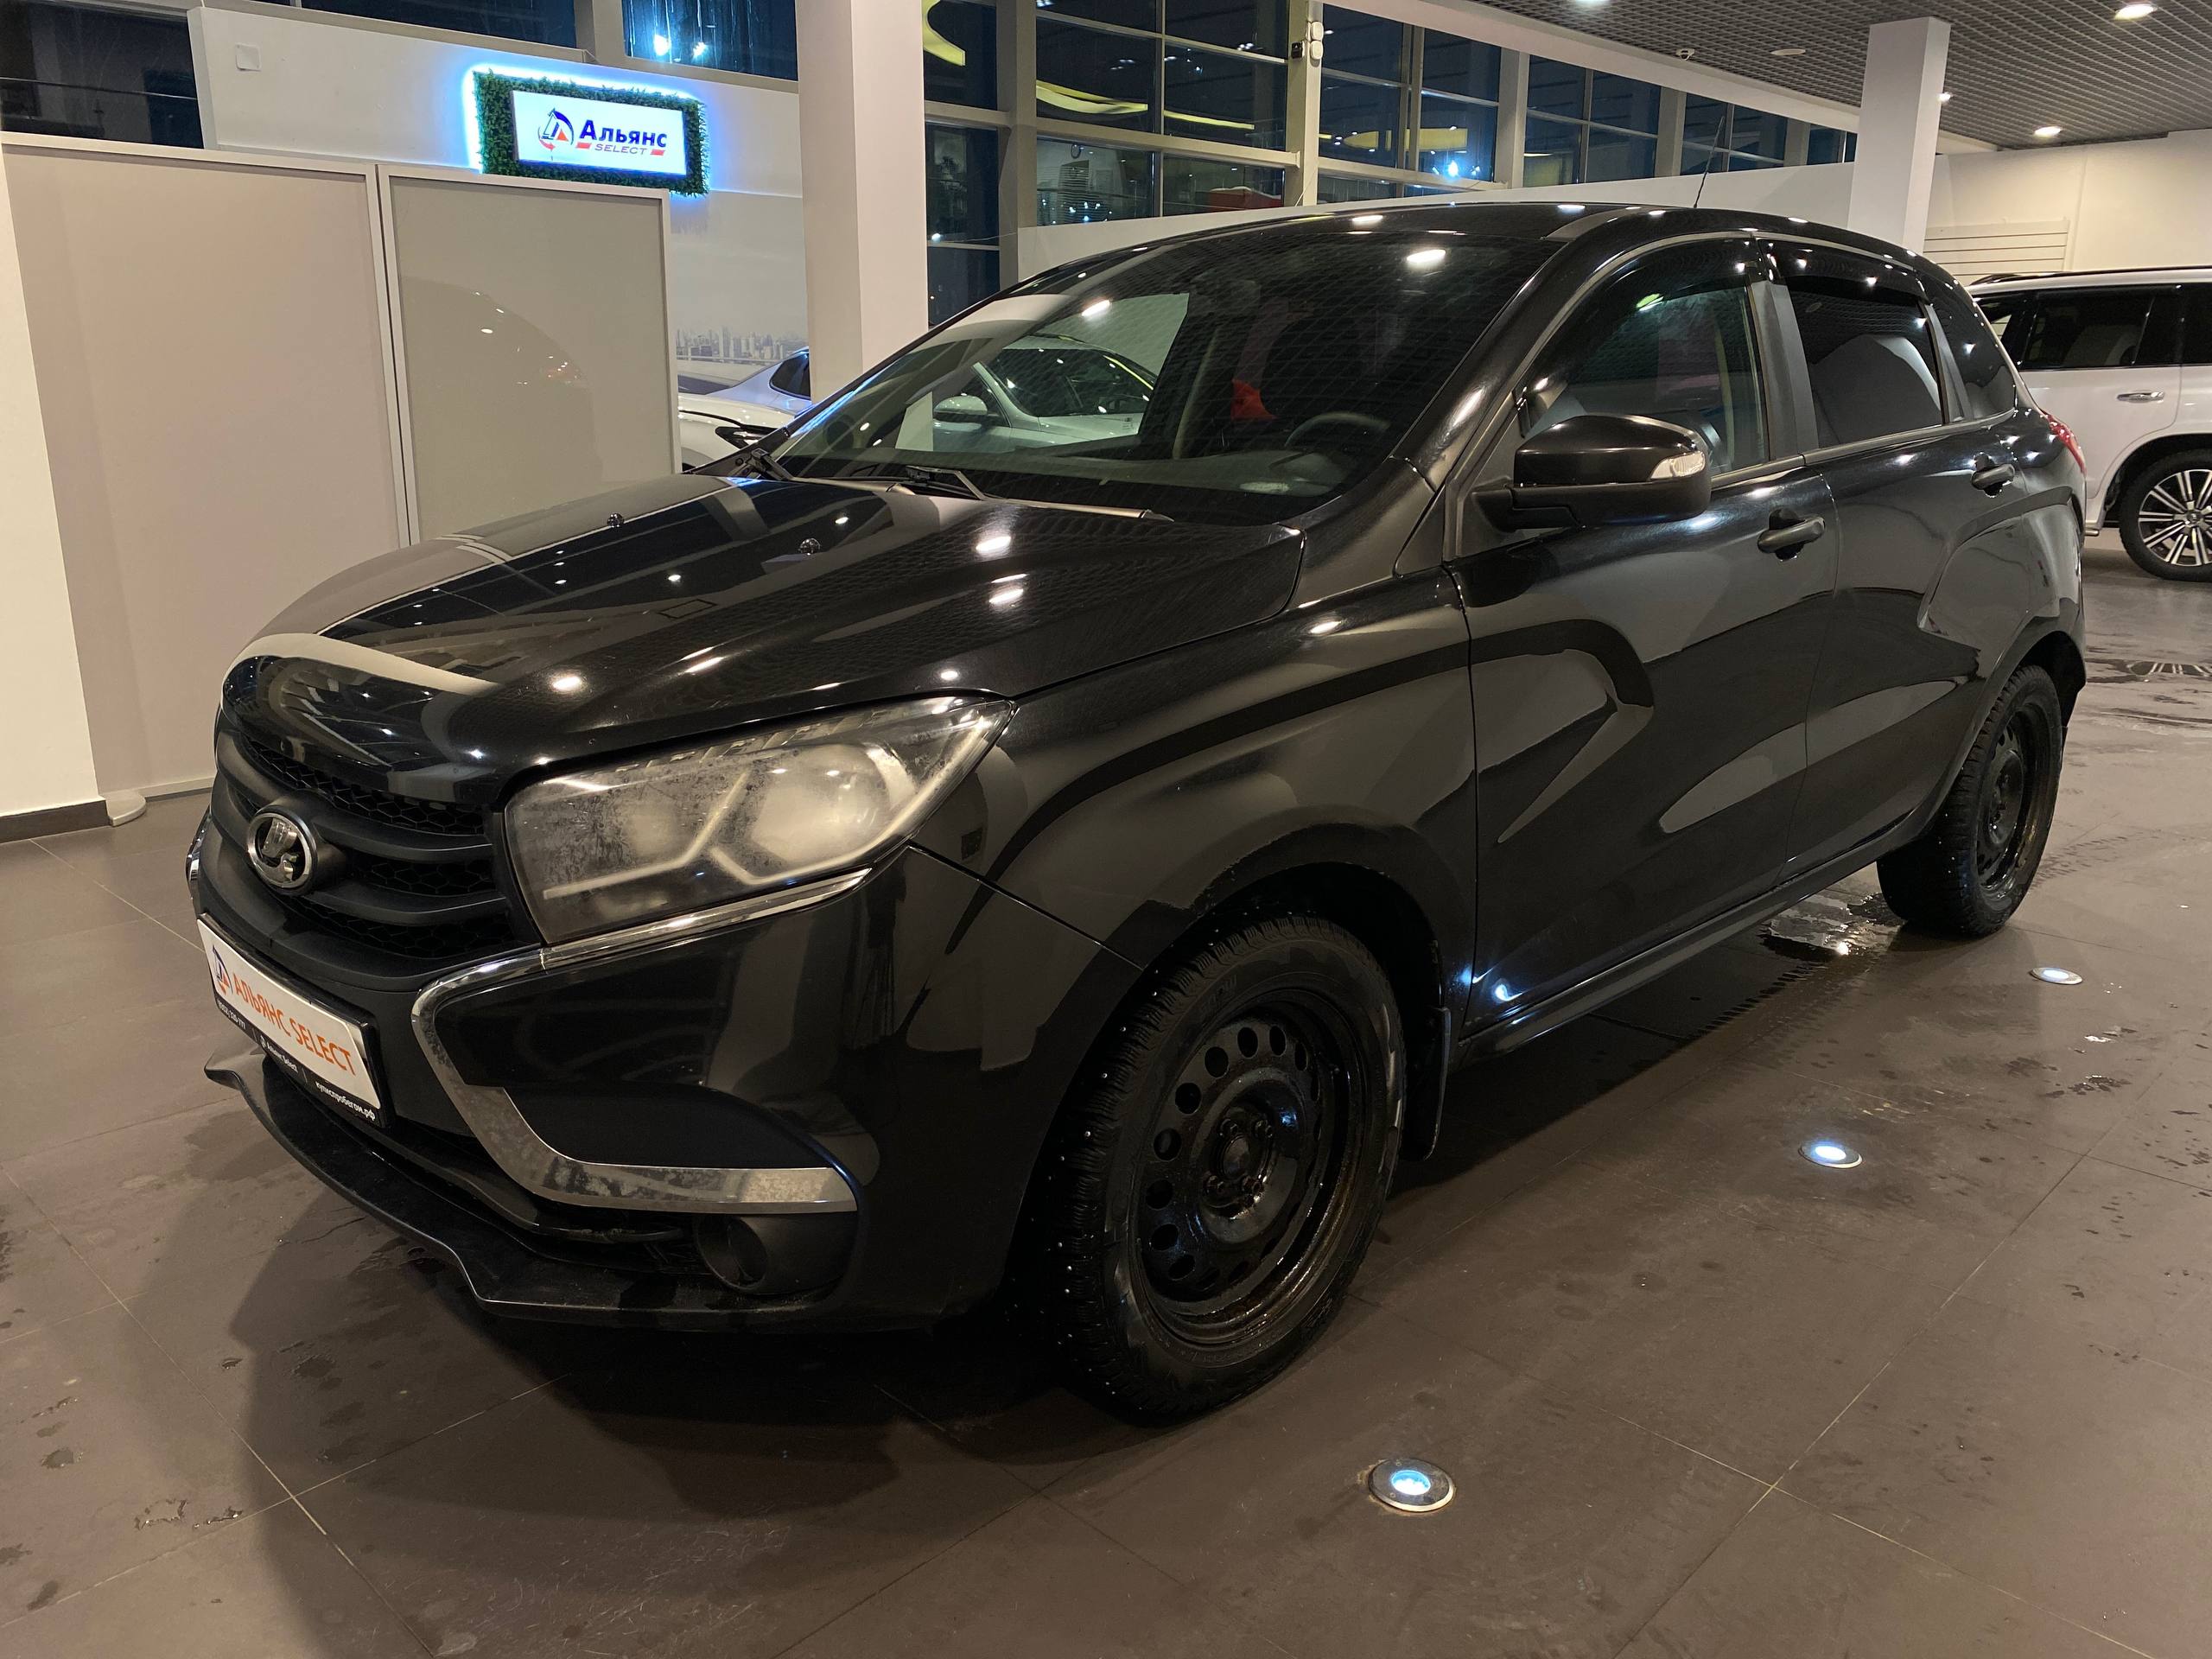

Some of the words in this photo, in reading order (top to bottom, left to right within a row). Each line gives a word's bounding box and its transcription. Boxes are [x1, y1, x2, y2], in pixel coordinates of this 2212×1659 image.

[579, 119, 667, 148] Альянс
[594, 143, 647, 156] SELECT
[232, 972, 291, 1037] АЛЬЯНС
[289, 1018, 356, 1075] SELECT
